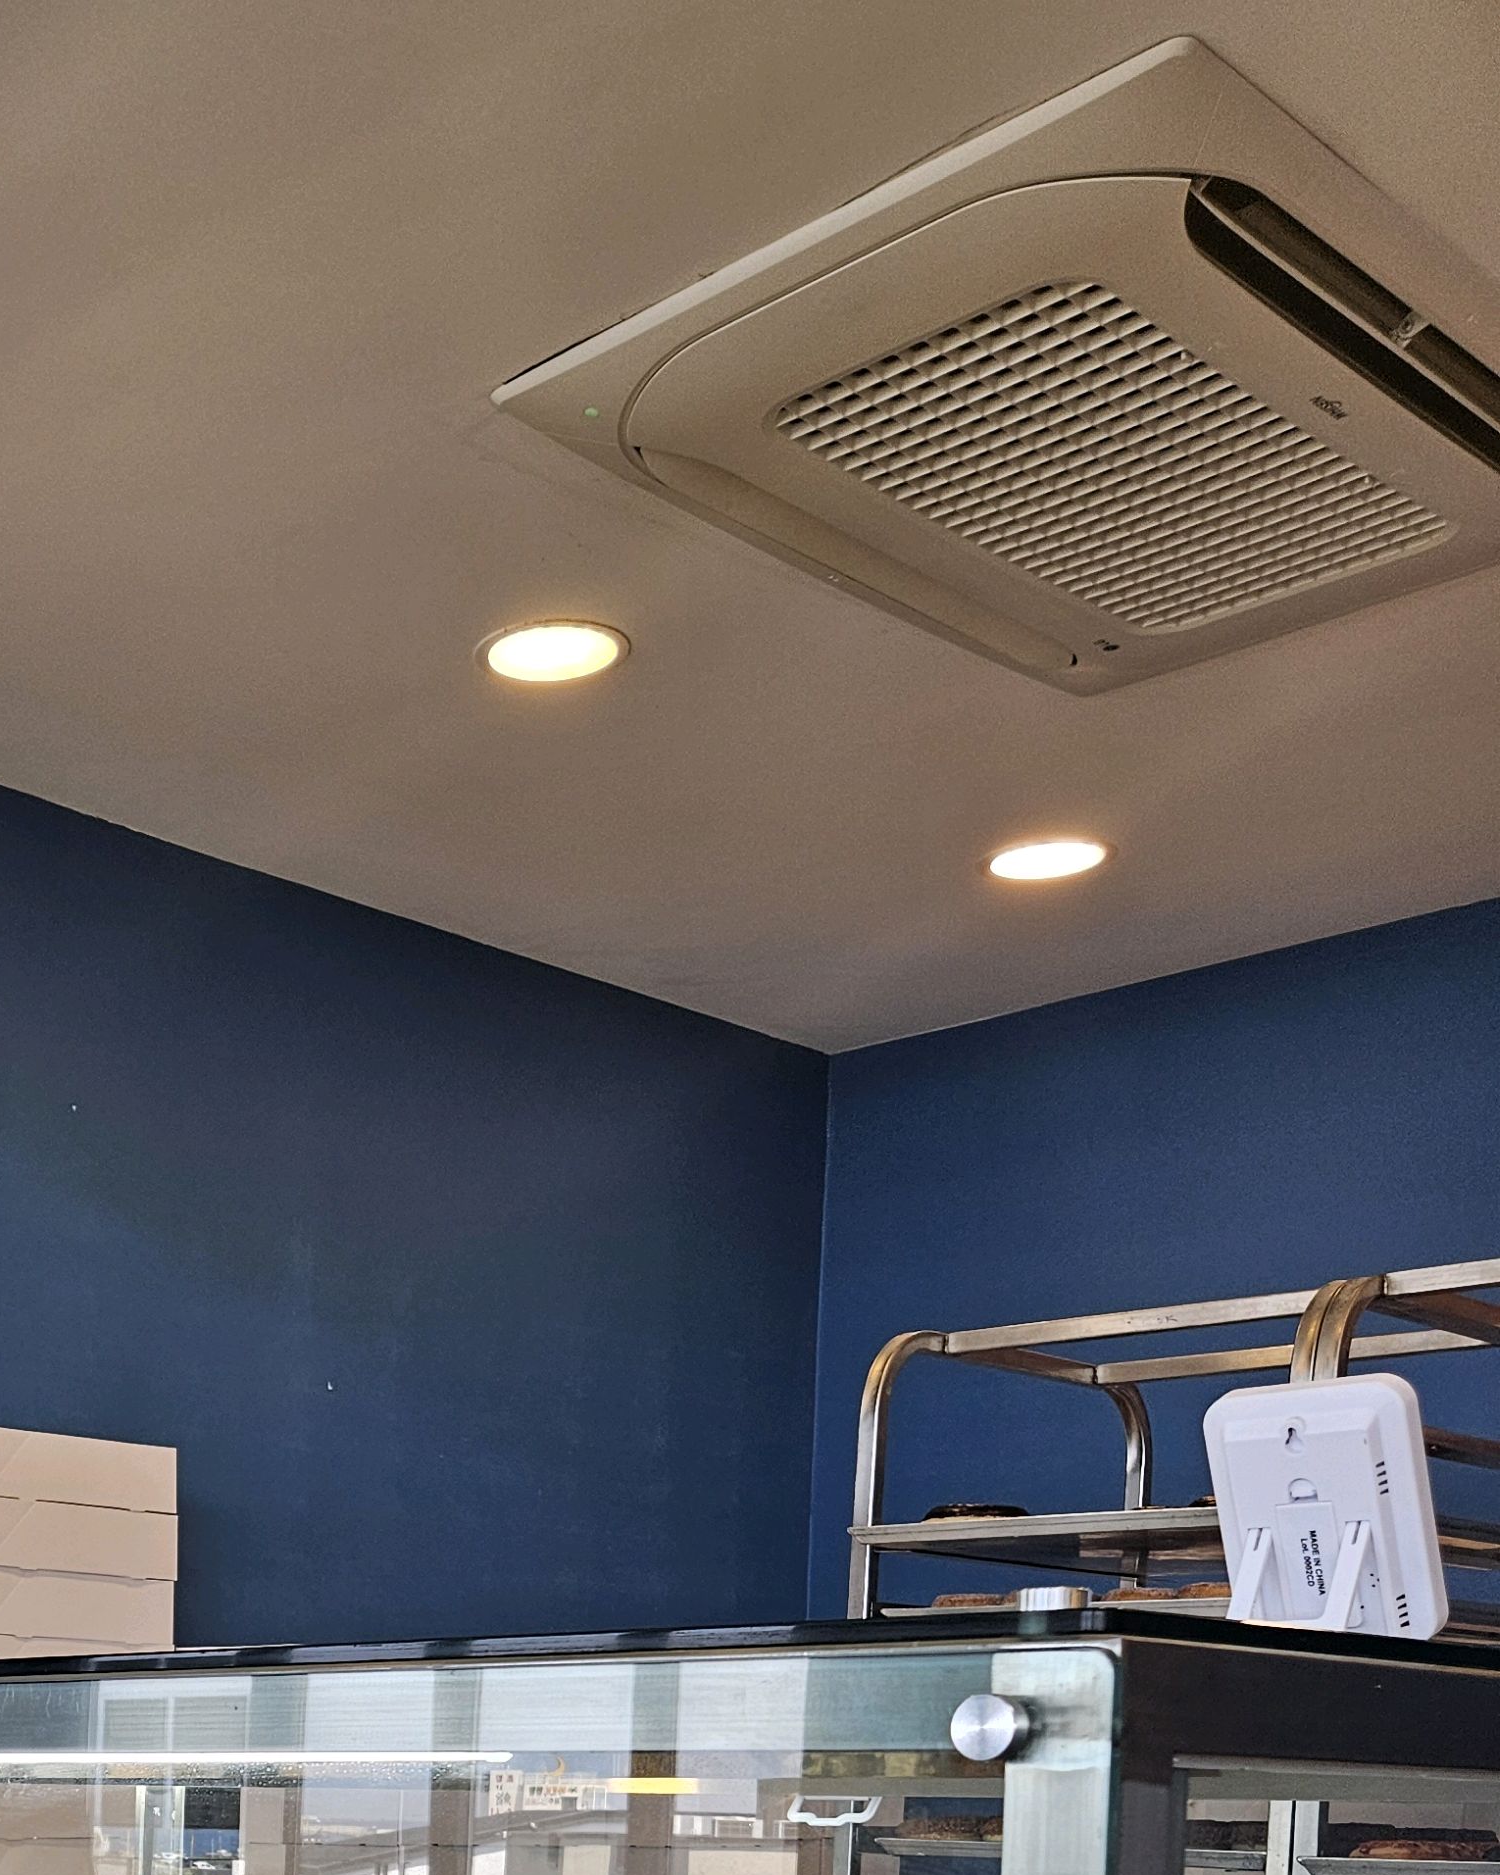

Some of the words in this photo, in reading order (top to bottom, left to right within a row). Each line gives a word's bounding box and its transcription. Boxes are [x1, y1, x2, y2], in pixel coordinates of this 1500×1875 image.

[1309, 1530, 1320, 1556] MADE
[1313, 1557, 1321, 1567] IN
[1315, 1568, 1326, 1596] CHINA
